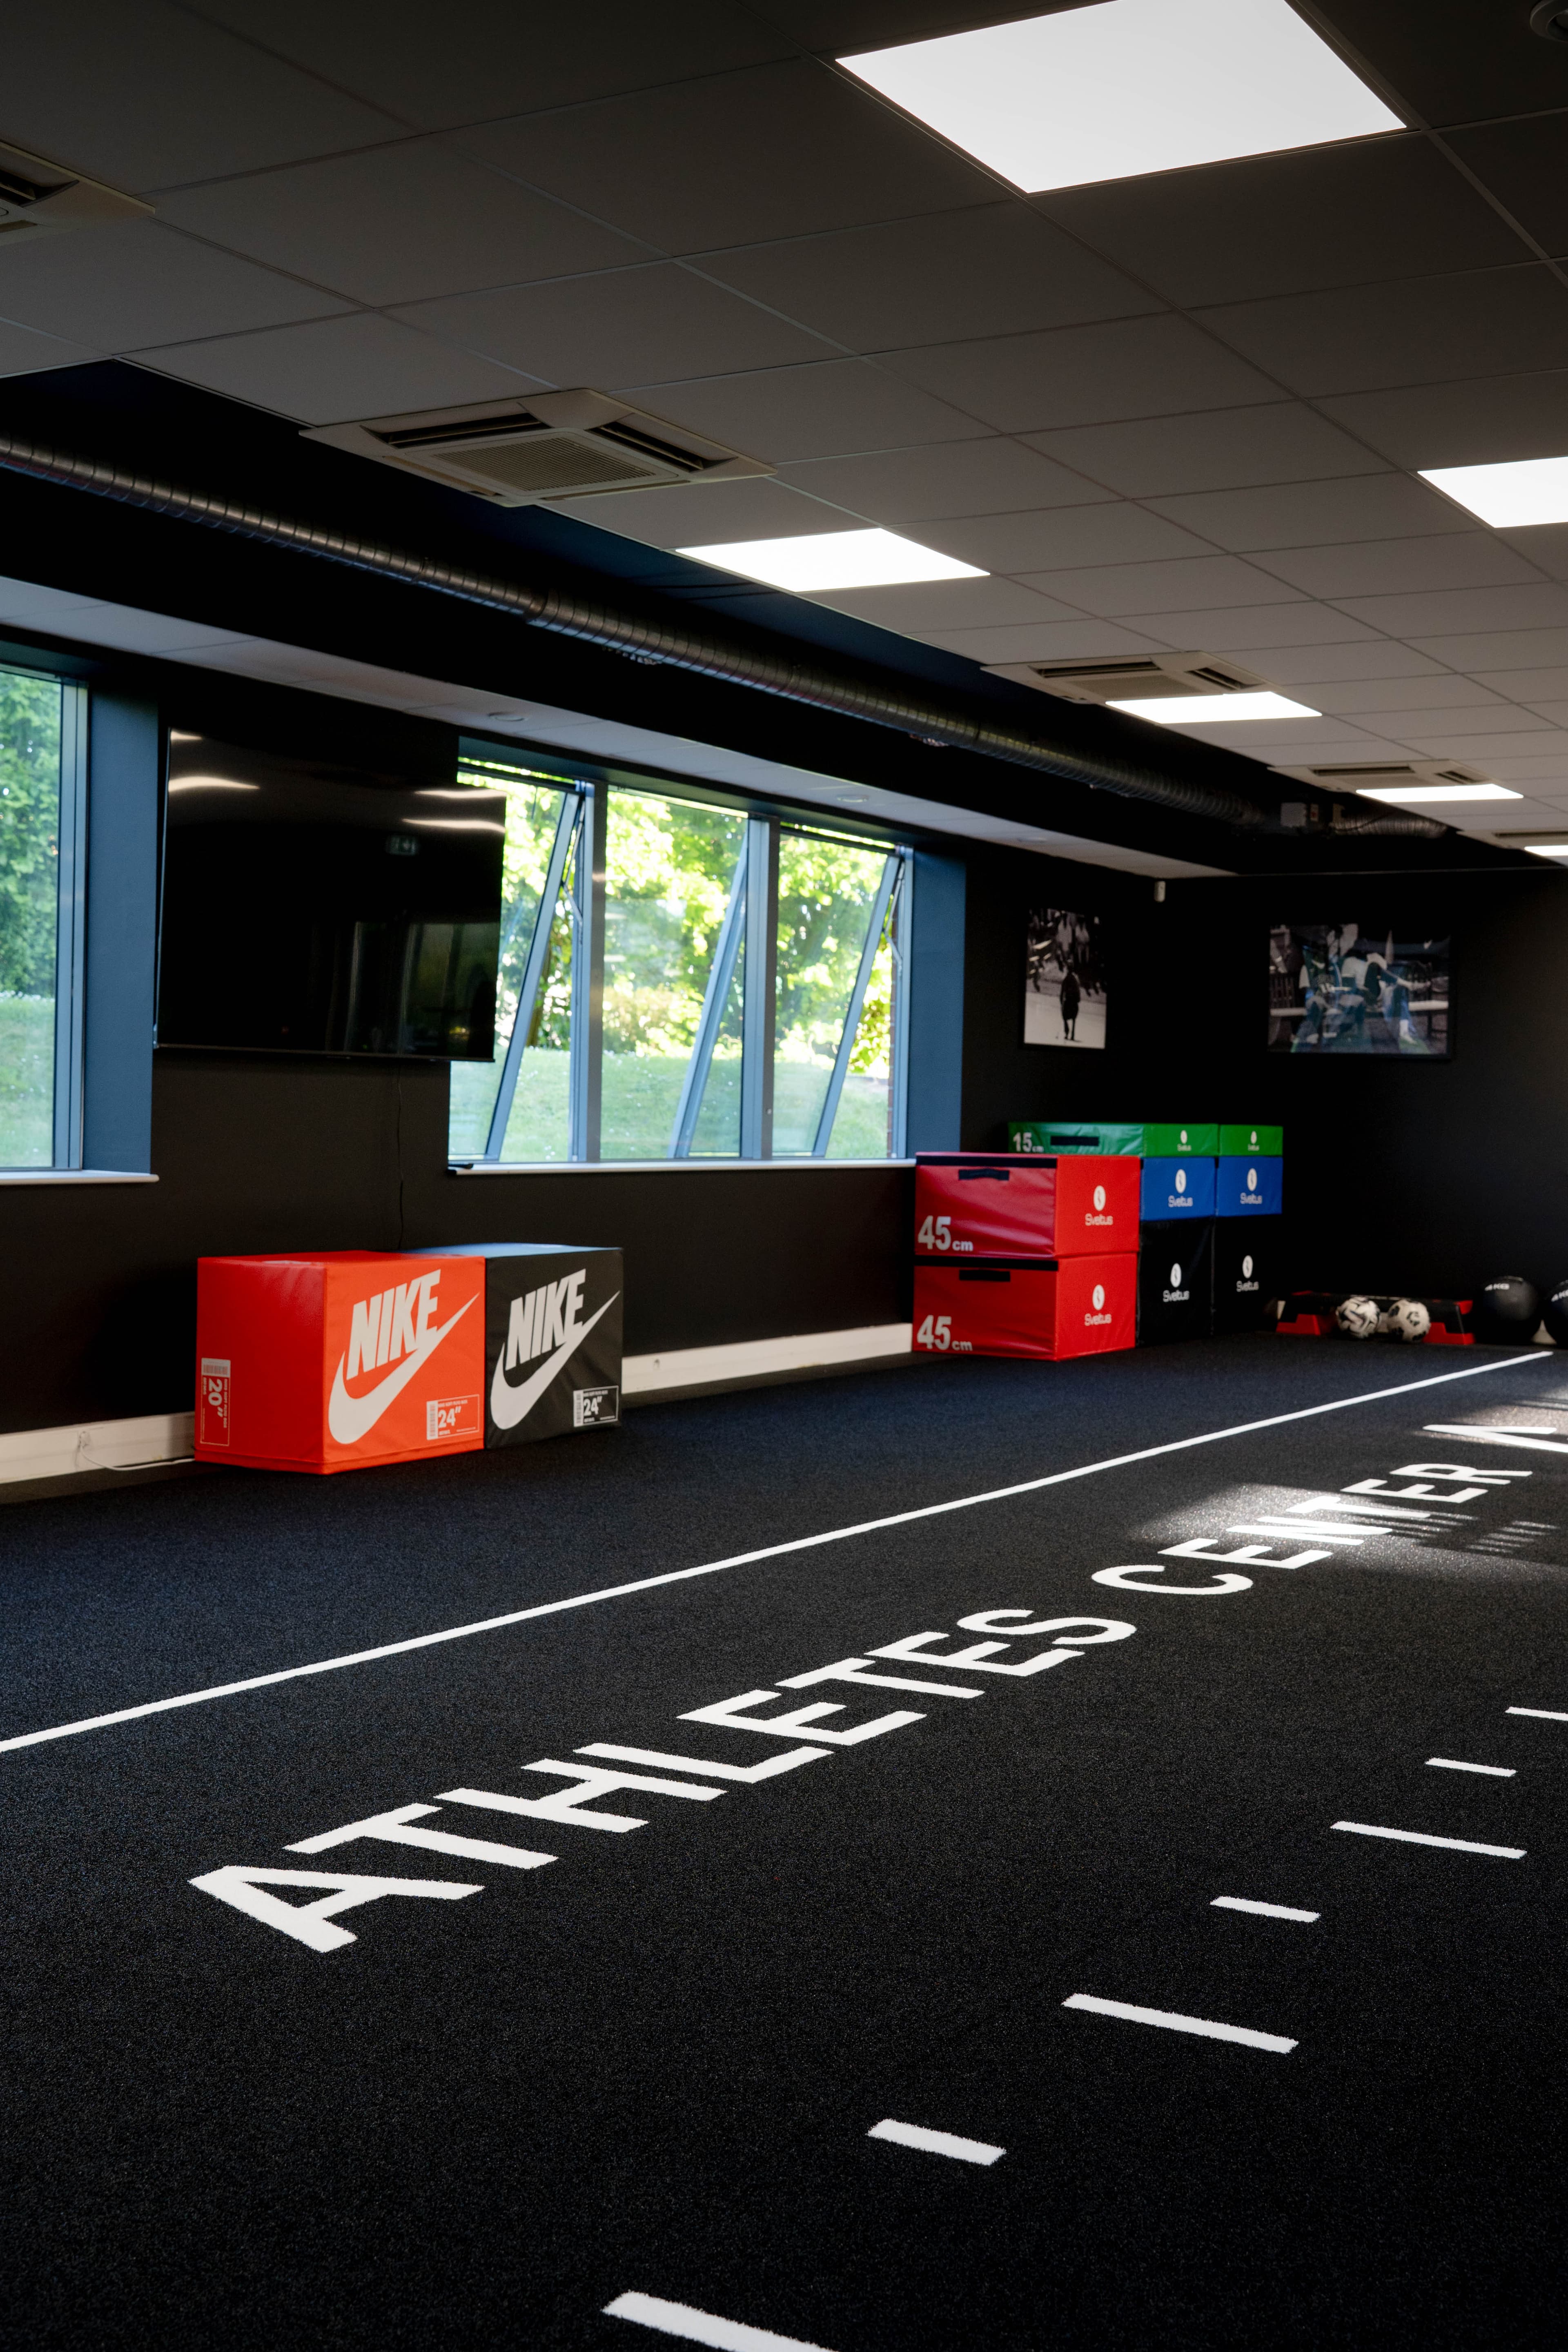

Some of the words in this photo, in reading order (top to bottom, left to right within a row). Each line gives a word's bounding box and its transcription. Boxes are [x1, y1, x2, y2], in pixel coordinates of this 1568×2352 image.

[347, 1269, 441, 1380] NIKE
[505, 1268, 586, 1371] NIKE
[187, 1609, 1136, 1953] ATHLETES
[1091, 1463, 1533, 1595] CENTER
